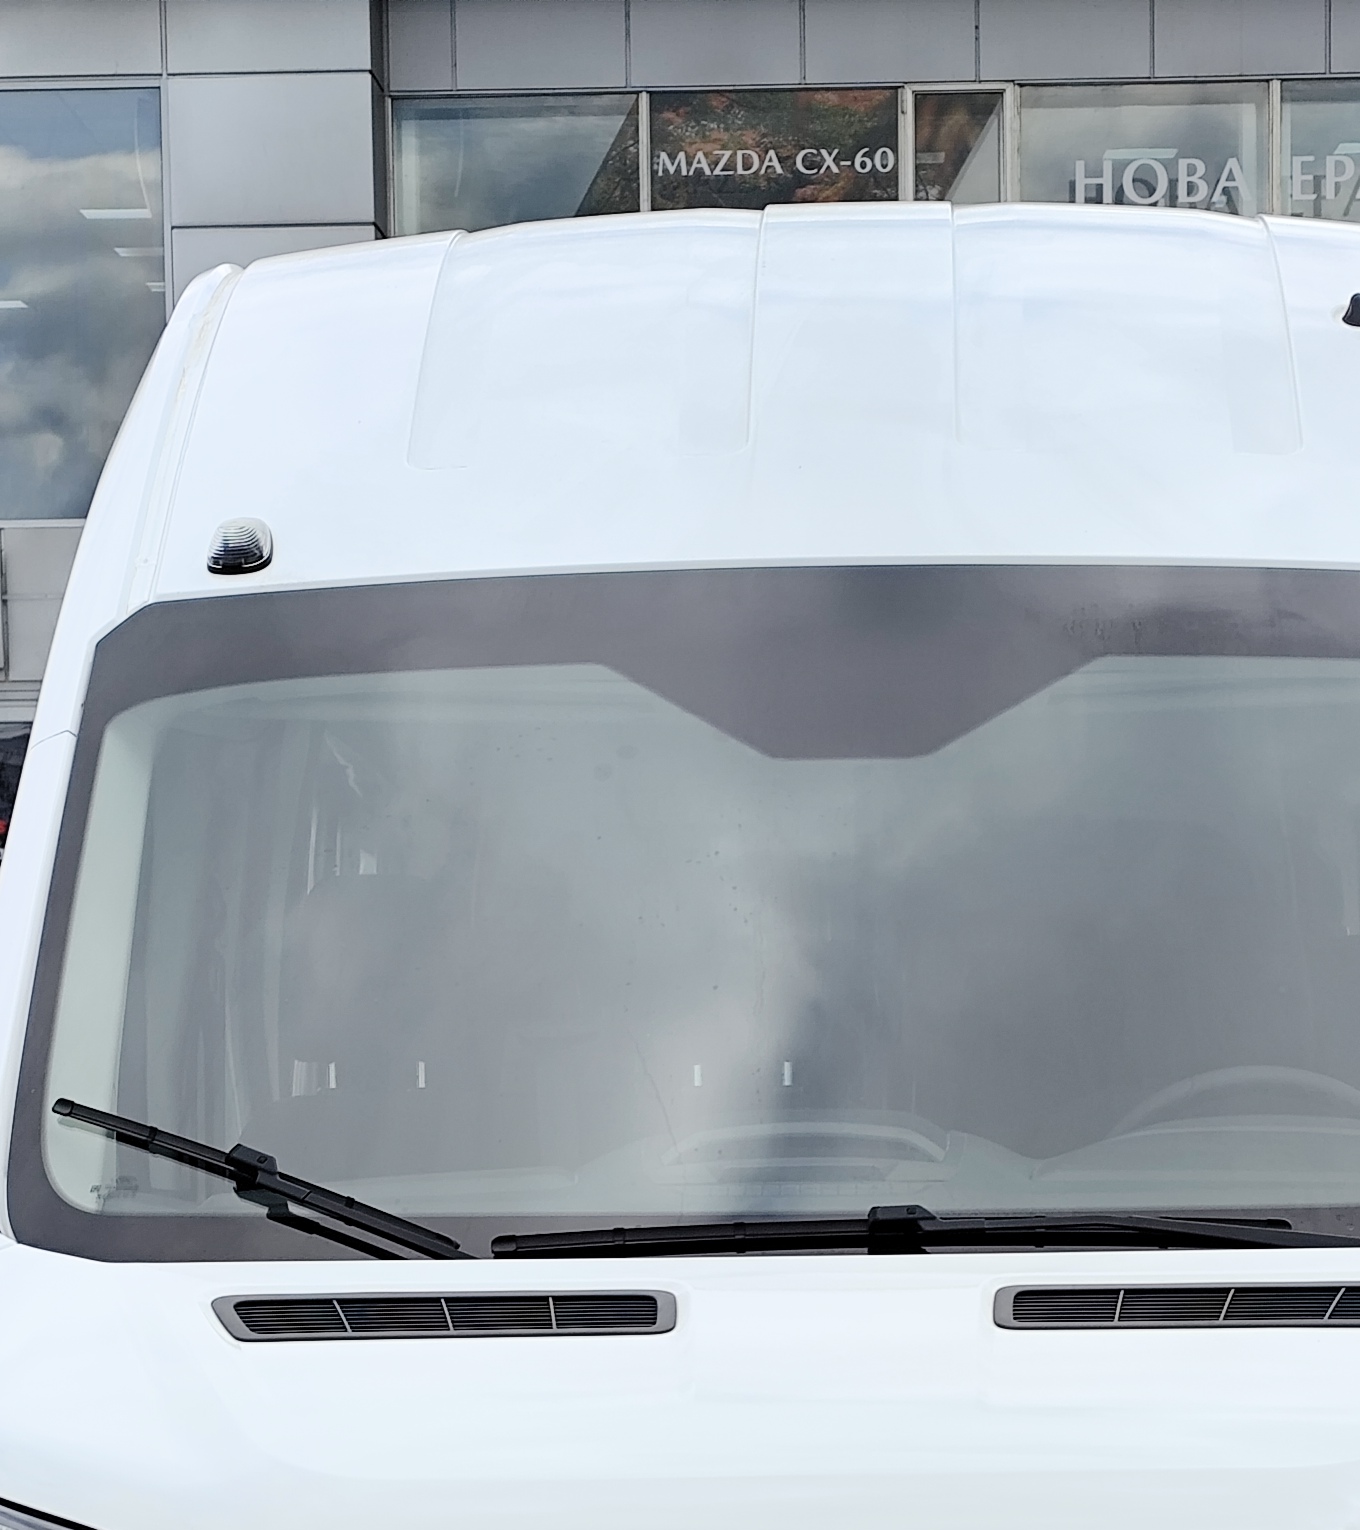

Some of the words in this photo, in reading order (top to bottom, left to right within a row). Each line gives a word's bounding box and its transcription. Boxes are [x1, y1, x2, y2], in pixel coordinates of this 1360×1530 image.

[657, 149, 784, 177] MAZDA
[795, 147, 895, 174] CX-60
[1074, 157, 1253, 204] НОВА
